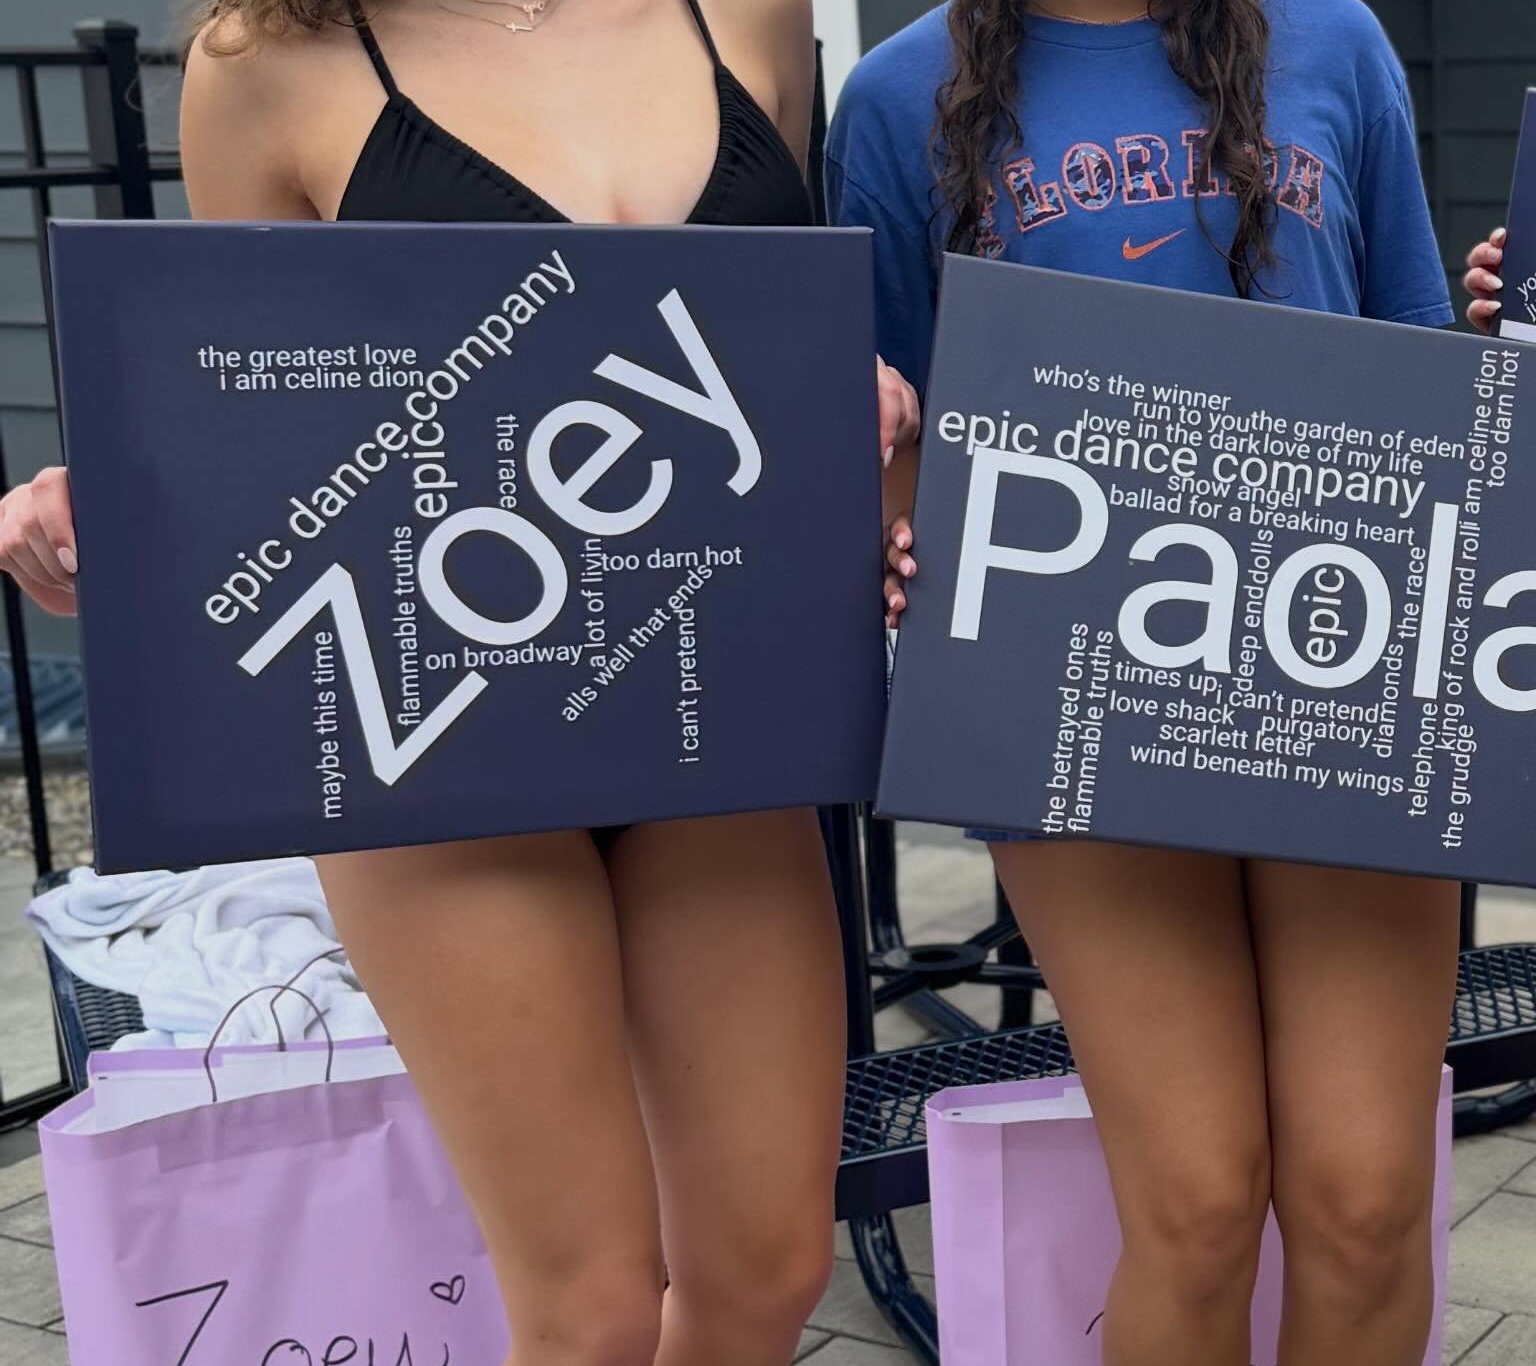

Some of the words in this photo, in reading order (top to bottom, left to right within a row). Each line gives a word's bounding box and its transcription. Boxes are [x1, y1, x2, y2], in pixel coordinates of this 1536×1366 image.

[976, 129, 1324, 259] LORIA
[198, 346, 241, 368] the
[249, 346, 356, 373] greatest
[364, 343, 417, 366] love
[220, 369, 226, 390] i
[235, 372, 277, 390] am
[285, 367, 361, 389] celine
[369, 366, 424, 387] dion
[1033, 364, 1100, 392] who's
[1107, 375, 1145, 398] the
[1152, 384, 1231, 412] winner
[205, 539, 292, 624] epic
[289, 421, 409, 541] dance
[405, 249, 576, 420] company
[496, 413, 519, 451] the
[1134, 401, 1170, 421] run
[1179, 406, 1201, 426] to
[1208, 412, 1250, 434] you
[1251, 411, 1287, 434] the
[1294, 420, 1373, 446] garden
[1380, 431, 1405, 450] of
[1410, 436, 1465, 459] eden
[402, 421, 458, 518] epic
[498, 459, 517, 509] race
[938, 410, 1039, 455] epic
[1054, 420, 1198, 478] dance
[1213, 453, 1425, 518] company
[236, 287, 762, 786] Zoey
[1110, 484, 1181, 513] ballad
[1190, 494, 1222, 518] for
[1228, 506, 1241, 522] a
[1250, 503, 1348, 540] breaking
[1355, 518, 1414, 546] heart
[389, 526, 414, 595] truths
[581, 539, 602, 582] livin
[601, 553, 639, 571] too
[647, 548, 698, 569] darn
[705, 546, 743, 566] hot
[582, 590, 604, 613] of
[1302, 567, 1348, 663] epic
[312, 631, 334, 685] time
[425, 653, 456, 670] on
[464, 643, 583, 668] broadway
[562, 685, 597, 721] alls
[594, 643, 634, 686] well
[629, 608, 671, 649] that
[668, 563, 712, 611] ends
[584, 619, 606, 648] lot
[673, 608, 702, 691] pretend
[1066, 623, 1089, 680] ones
[393, 602, 421, 726] flammable
[590, 656, 606, 667] a
[313, 690, 337, 733] this
[676, 699, 698, 750] can't
[1109, 689, 1158, 716] love
[1165, 699, 1235, 726] shack
[1373, 643, 1404, 758] diamonds
[1046, 687, 1081, 789] betrayed
[1159, 724, 1248, 749] scarlett
[1255, 730, 1315, 758] letter
[1261, 715, 1373, 748] purgatory
[316, 740, 346, 819] maybe
[1130, 743, 1186, 768] wind
[1194, 747, 1288, 781] beneath
[1295, 765, 1330, 788] my
[1337, 768, 1404, 796] wings
[1408, 702, 1438, 817] telephone
[1041, 796, 1066, 833] the
